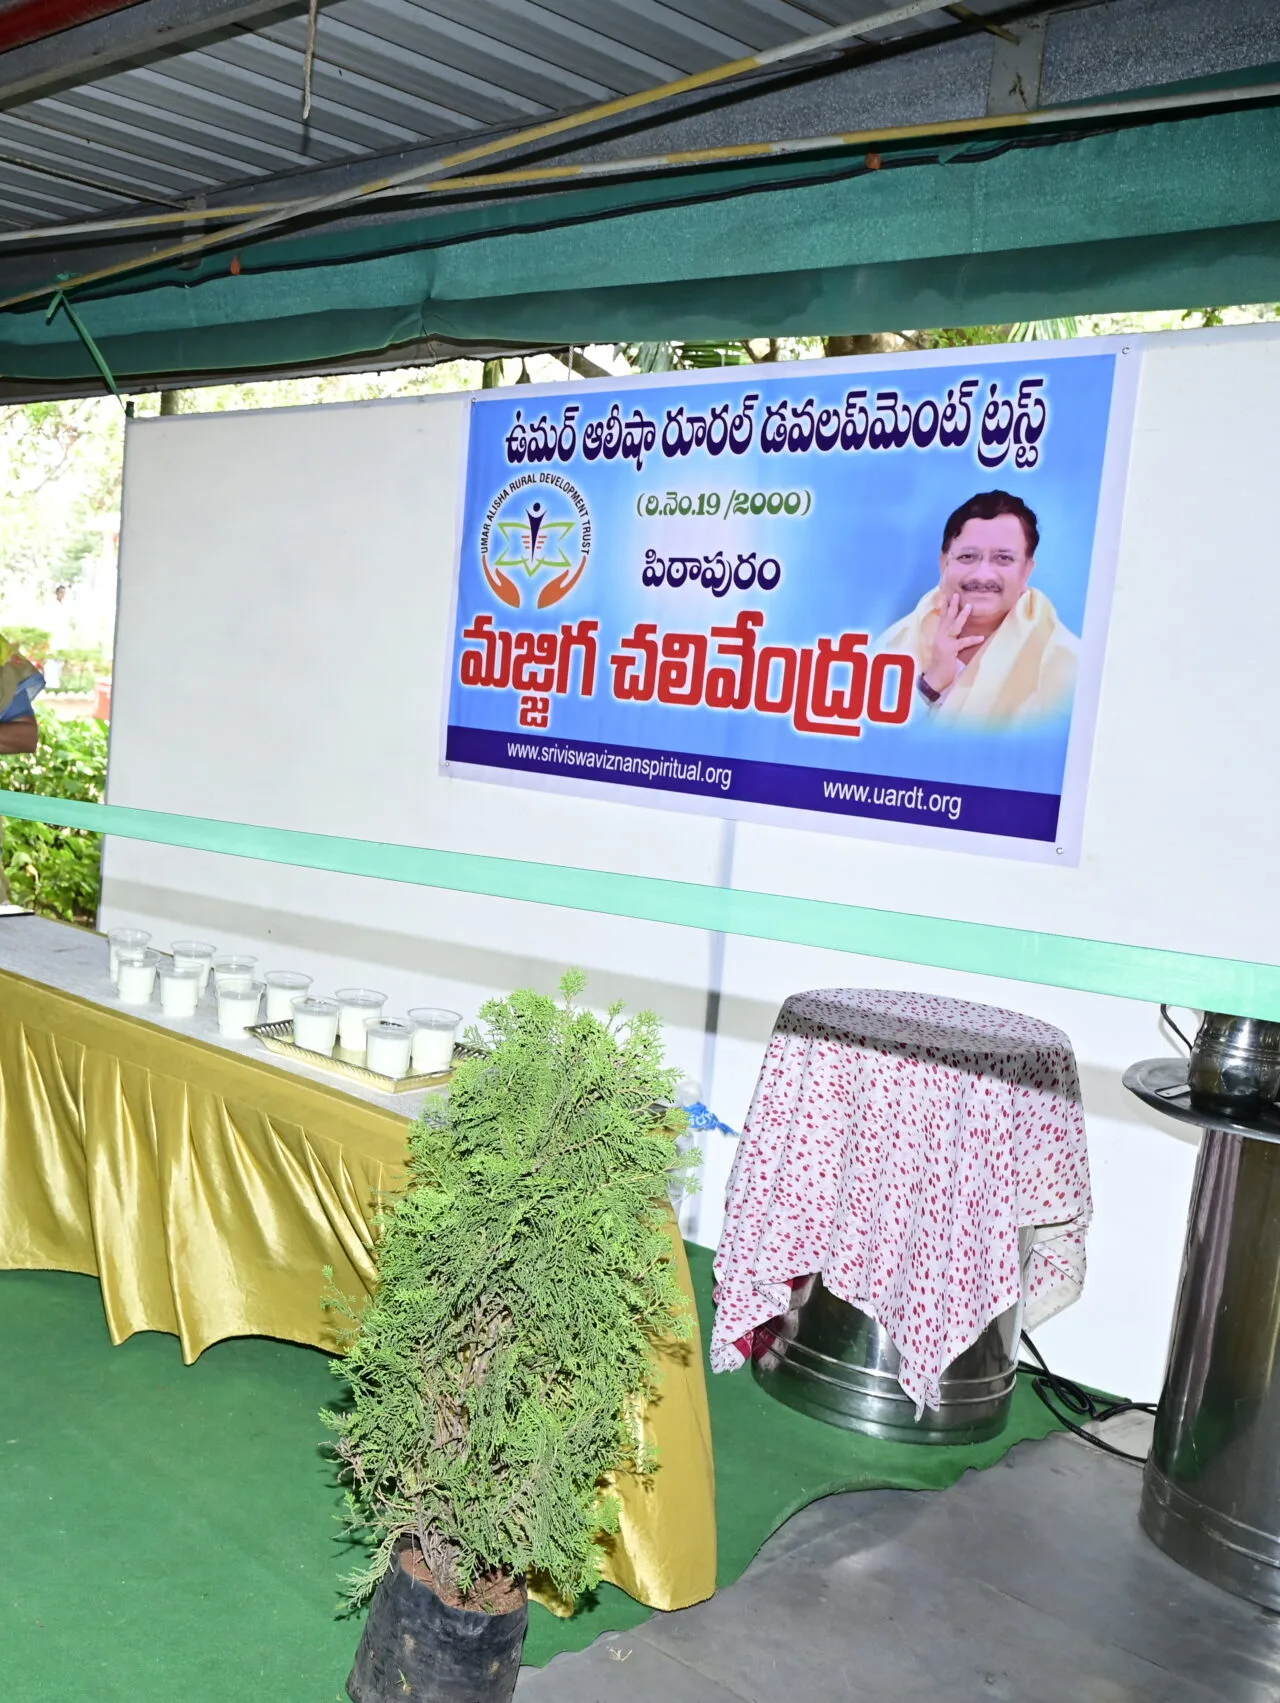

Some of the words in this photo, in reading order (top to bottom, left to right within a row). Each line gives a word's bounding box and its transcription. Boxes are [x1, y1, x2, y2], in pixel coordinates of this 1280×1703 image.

[505, 406, 580, 464] ఉమర్
[582, 403, 656, 472] ఆలీషా
[661, 394, 759, 458] రూరల్
[977, 378, 1046, 469] ట్రస్ట్
[481, 523, 491, 554] UMAR
[486, 489, 510, 522] ALISHA
[509, 473, 537, 493] RURAL
[539, 472, 589, 518] DEVELOPMENT
[581, 519, 591, 555] TRUST
[642, 548, 781, 598] పిఠాపురం
[461, 615, 599, 728] మజ్జిగ
[611, 610, 915, 737] చలివేంద్రం
[507, 742, 732, 791] www.sriviswaviznanspiritual.org
[823, 780, 962, 820] www.uardt.org
